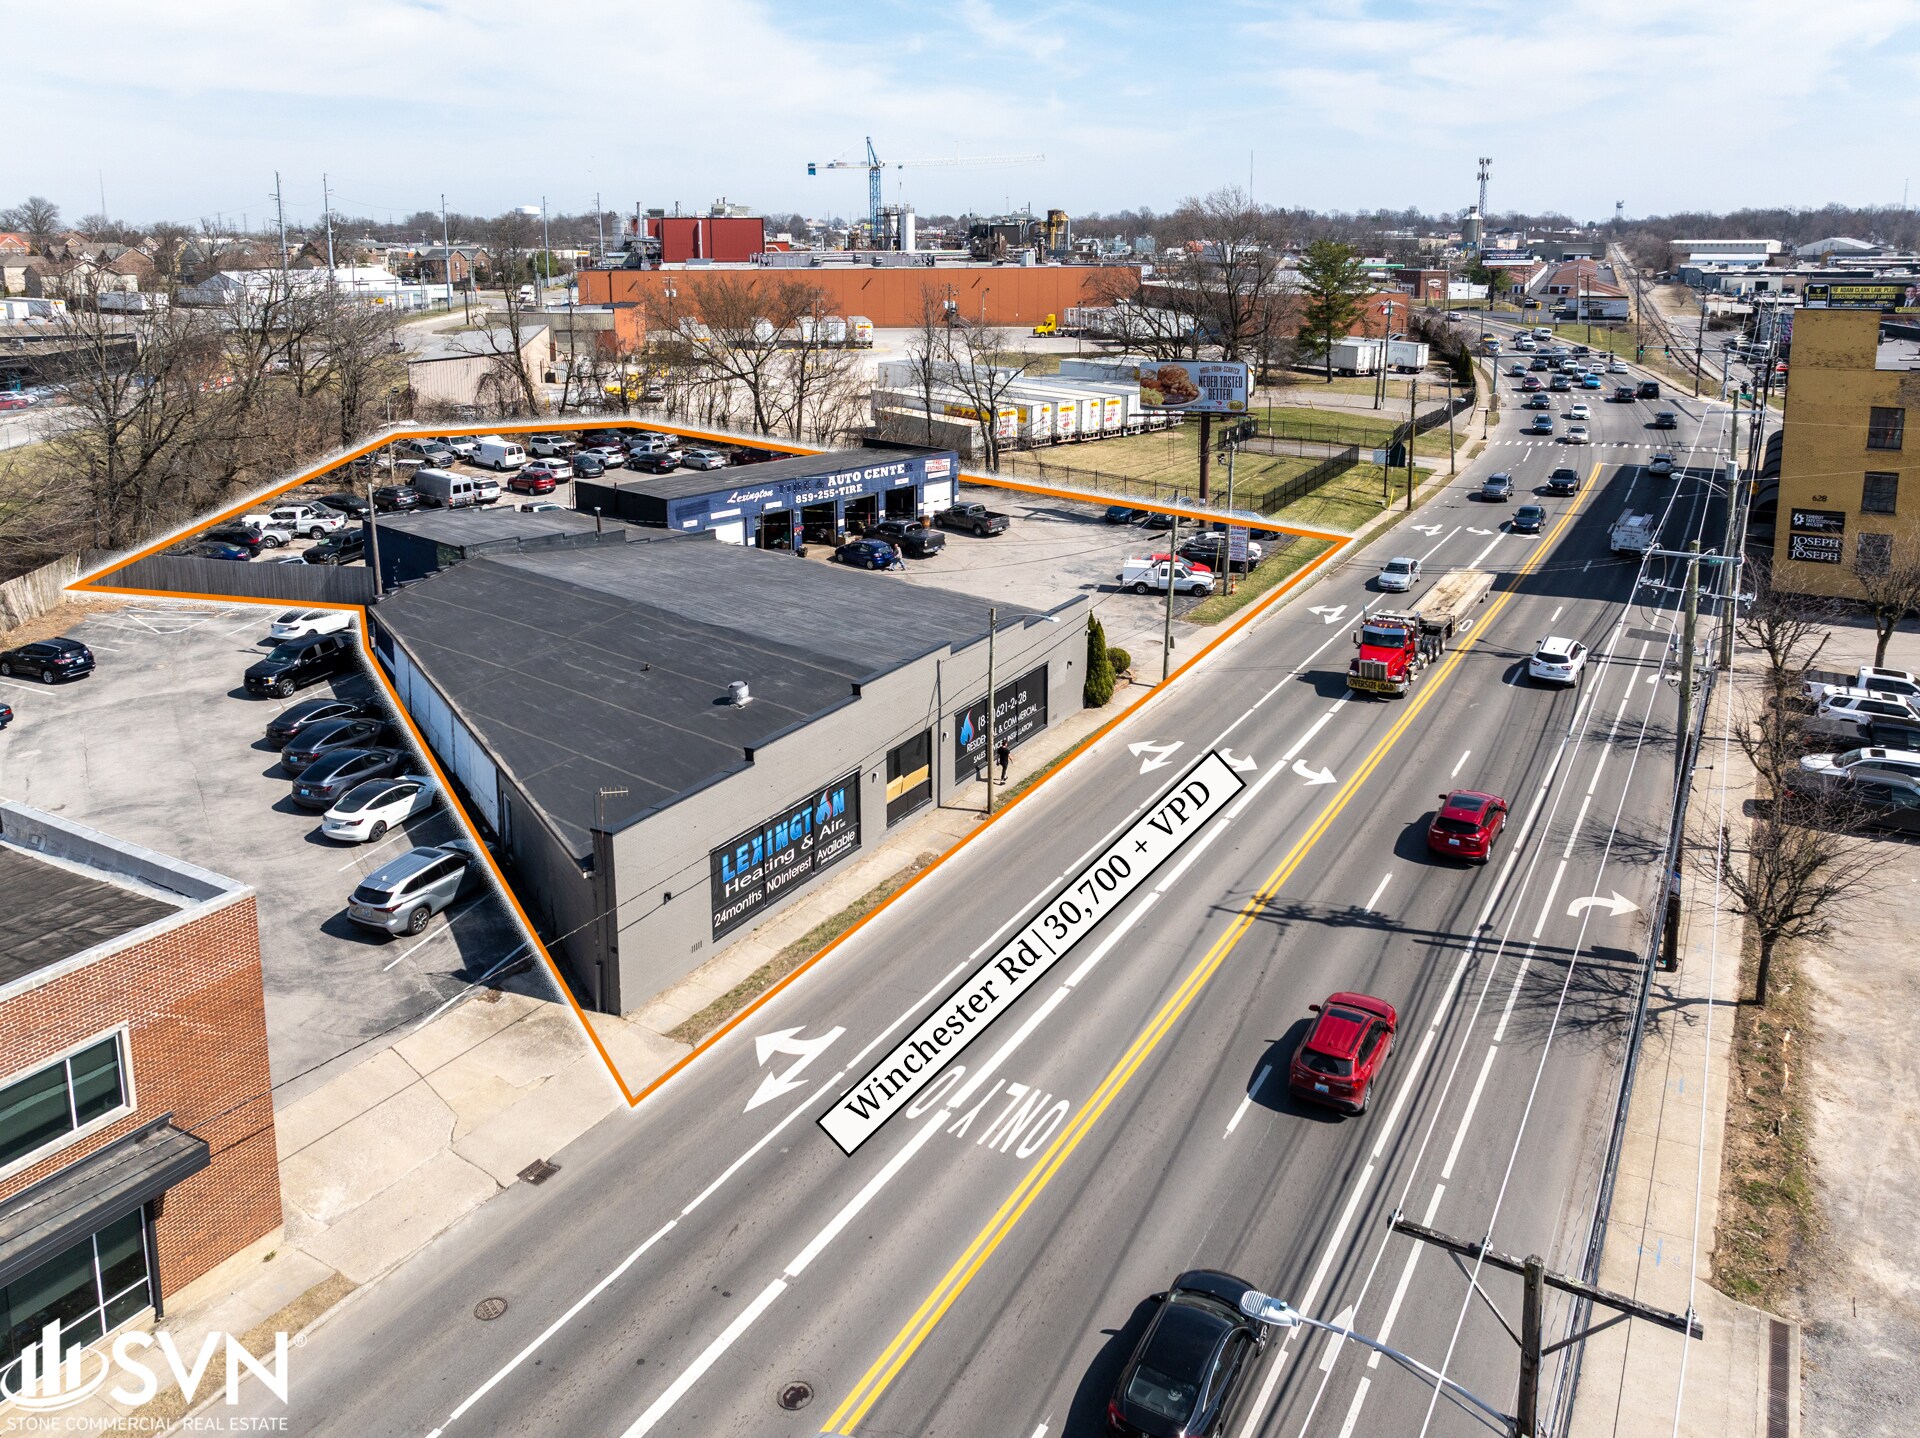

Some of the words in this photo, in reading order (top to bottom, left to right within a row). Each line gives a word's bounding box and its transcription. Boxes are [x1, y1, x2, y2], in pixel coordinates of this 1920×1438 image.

[1198, 375, 1218, 388] NEVER
[1219, 375, 1243, 388] TASTED
[1208, 388, 1233, 400] BETTER!
[726, 488, 774, 504] Lexington
[828, 471, 862, 487] AUTO
[1812, 494, 1828, 502] 628
[1791, 535, 1840, 548] JOSEPH
[1790, 549, 1839, 561] JOSEPH
[1349, 678, 1377, 690] OVERSIZE
[1377, 682, 1394, 691] LOAD
[996, 690, 1028, 718] 621-228
[973, 749, 987, 764] SALES
[816, 830, 856, 862] Available
[725, 847, 795, 898] Heating
[801, 833, 814, 851] &
[819, 818, 843, 841] Air
